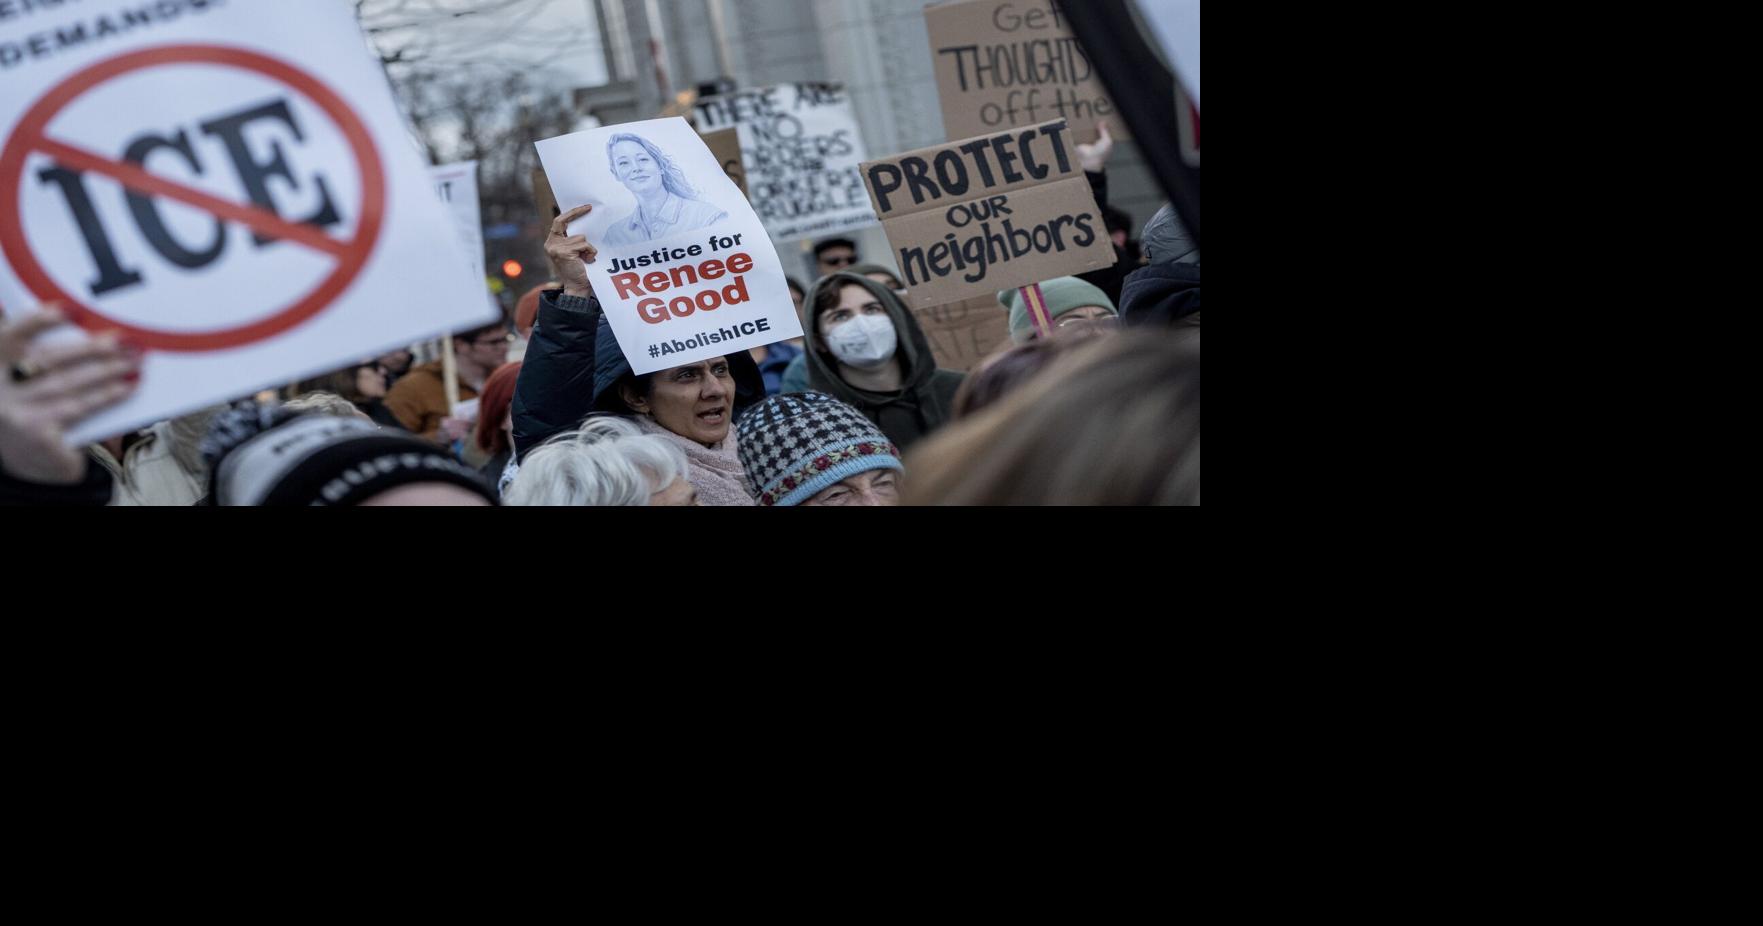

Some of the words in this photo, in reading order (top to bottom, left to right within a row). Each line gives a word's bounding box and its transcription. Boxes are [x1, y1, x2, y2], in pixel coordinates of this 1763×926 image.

[993, 3, 1063, 32] Get
[938, 37, 1092, 91] THOUGHTS
[980, 89, 1041, 126] off
[1049, 86, 1114, 119] the
[868, 119, 1072, 213] PROTECT
[37, 97, 341, 296] ICE
[946, 195, 1013, 227] OUR
[606, 243, 703, 274] Justice
[709, 232, 743, 258] for
[901, 212, 1095, 286] neighbors
[610, 251, 754, 301] Renee
[637, 275, 750, 325] Good
[648, 317, 772, 359] #AbolishICE
